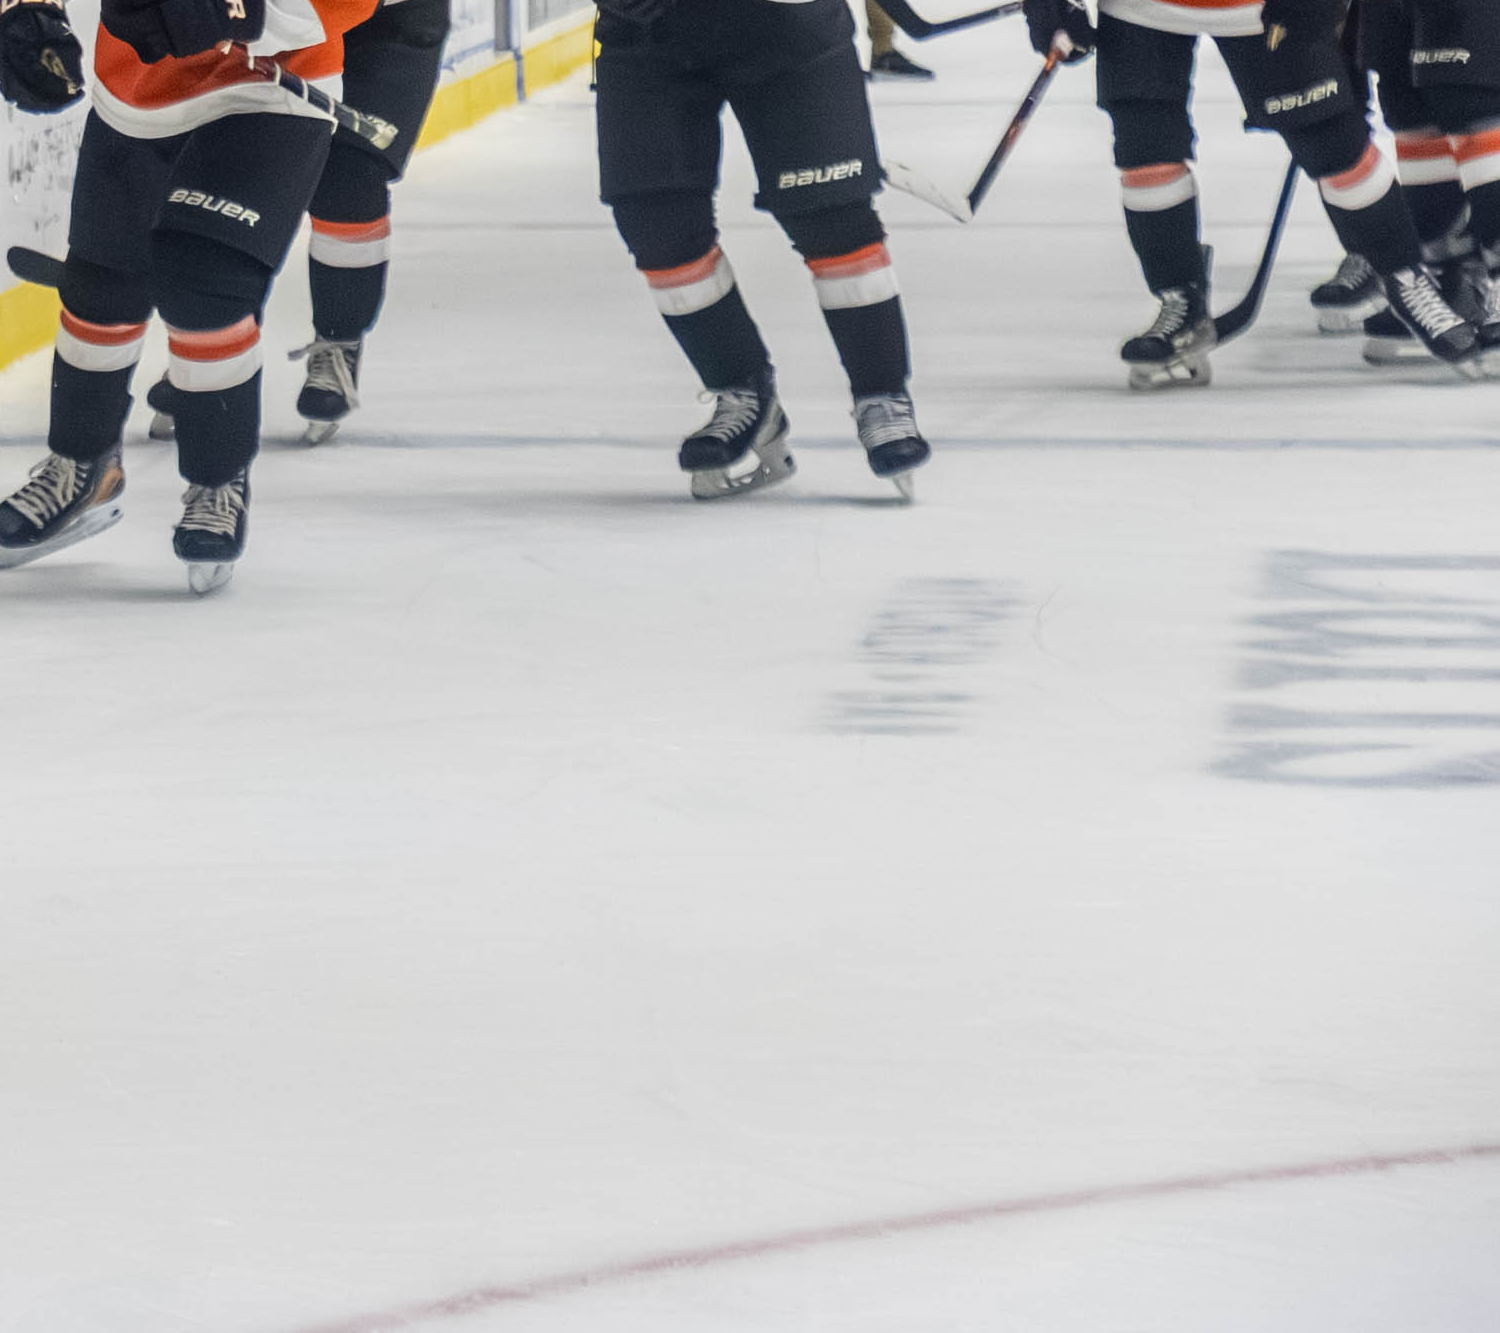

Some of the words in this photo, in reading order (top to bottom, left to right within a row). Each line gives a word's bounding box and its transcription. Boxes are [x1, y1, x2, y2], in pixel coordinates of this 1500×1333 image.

[1265, 79, 1339, 115] BAUER
[778, 159, 864, 189] BAUER
[168, 188, 261, 228] BAUER
